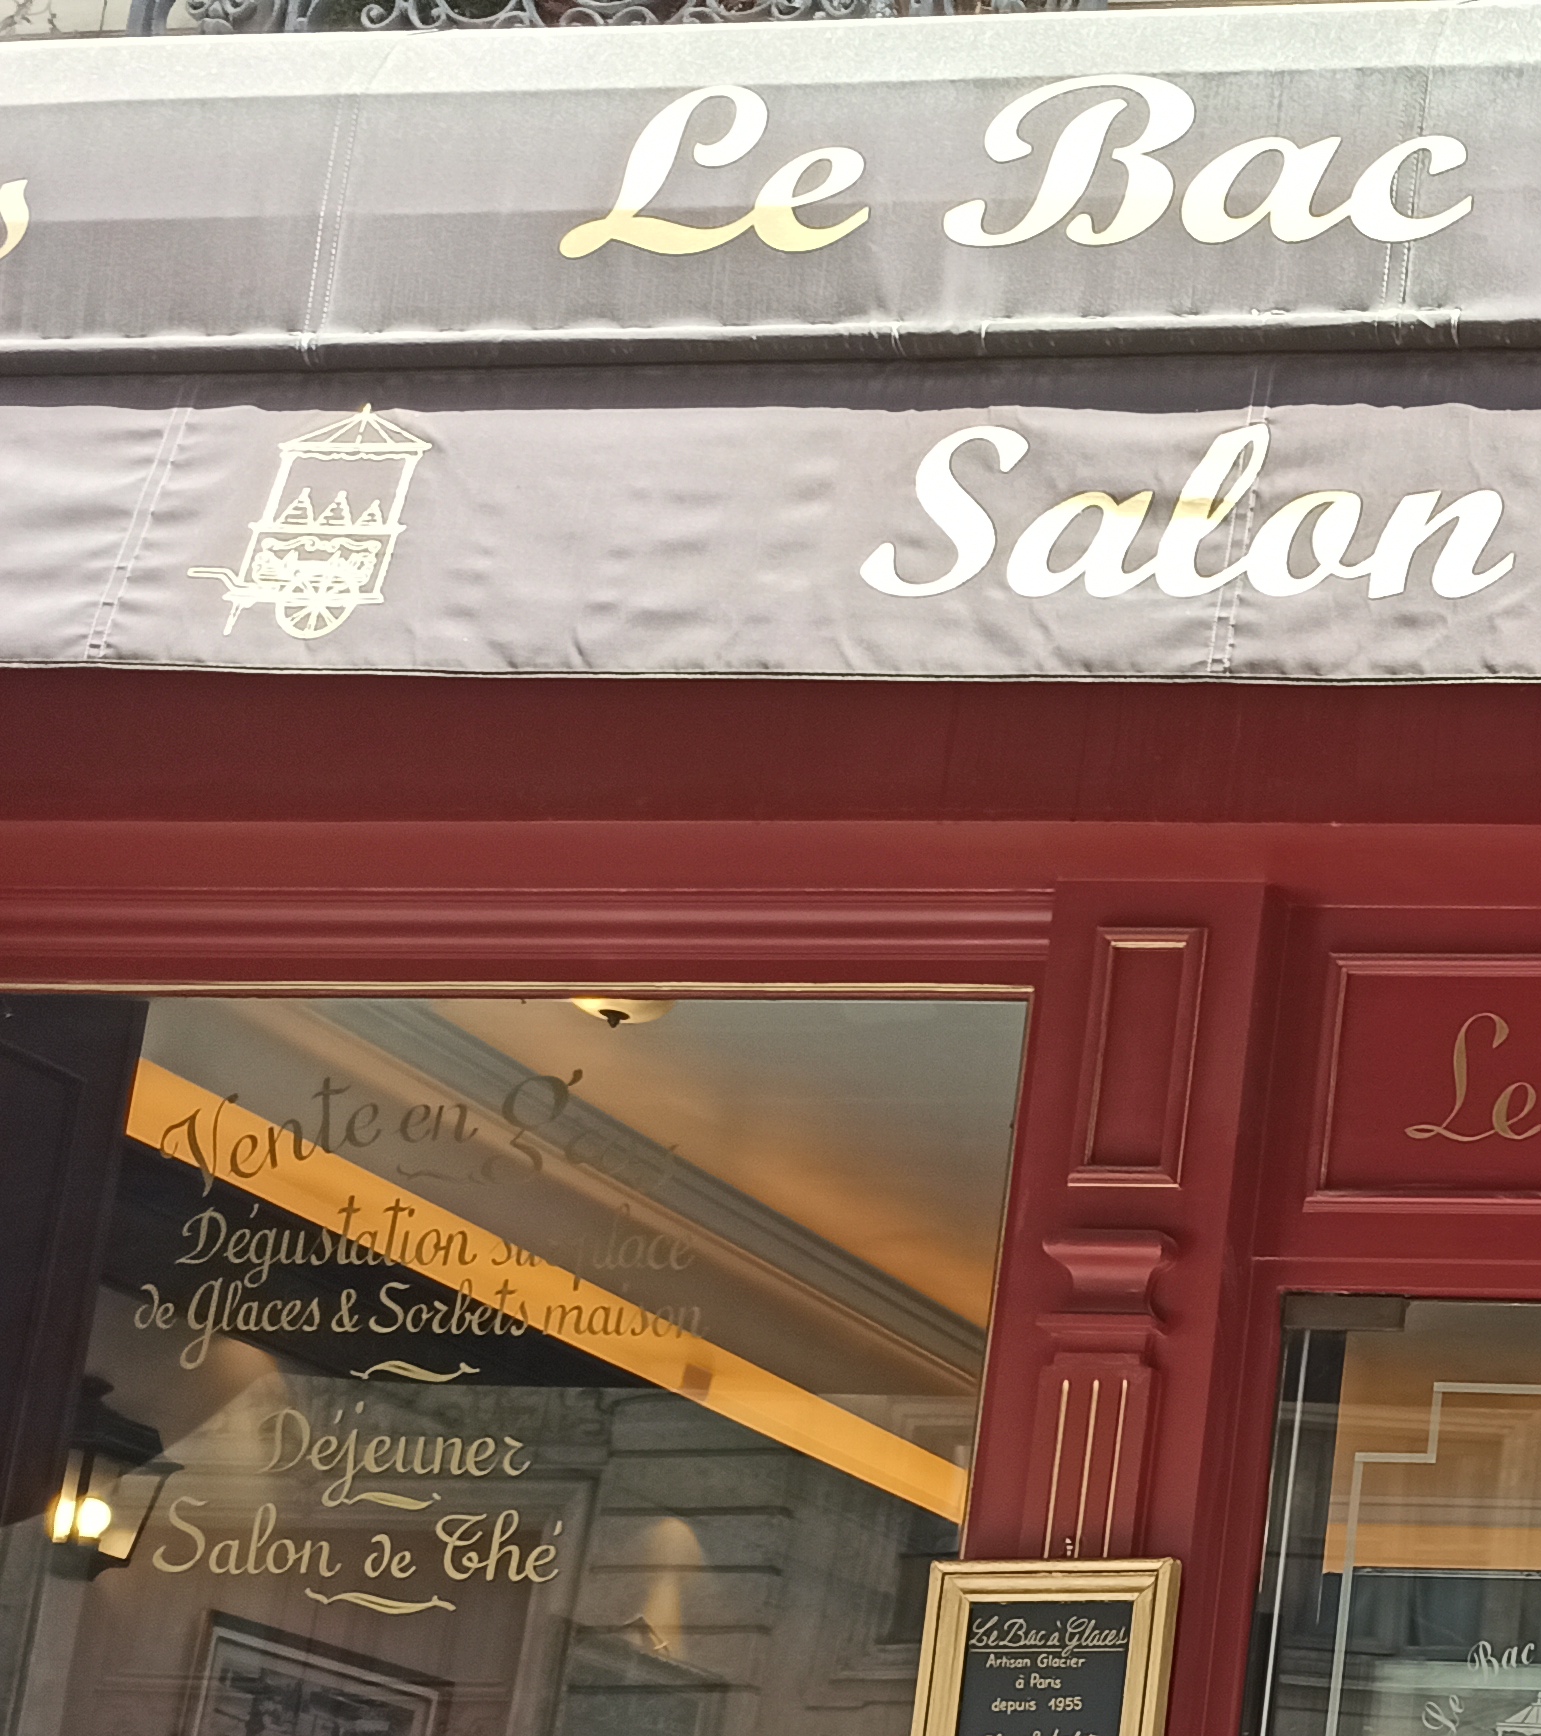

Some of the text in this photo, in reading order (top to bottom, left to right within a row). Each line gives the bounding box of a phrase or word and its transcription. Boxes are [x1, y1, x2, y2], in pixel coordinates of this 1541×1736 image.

[559, 84, 870, 258] Le
[943, 75, 1473, 248] Bac
[861, 420, 1514, 600] Salon
[1405, 1012, 1541, 1142] Le
[160, 1077, 382, 1198] Vente
[395, 1102, 479, 1144] en
[175, 1195, 477, 1288] Dégustation
[134, 1284, 177, 1330] de
[331, 1289, 363, 1332] &
[369, 1278, 527, 1336] Sorbets
[542, 1303, 709, 1339] maison
[258, 1401, 531, 1507] Déjeuner
[152, 1496, 563, 1583] Salon de Thé
[970, 1615, 1127, 1657] Le Bac à Glaces
[986, 1654, 1086, 1668] Artisan Glacier
[1467, 1640, 1535, 1681] Bac
[991, 1697, 1082, 1715] depuis 1955
[1015, 1673, 1061, 1689] à Paris
